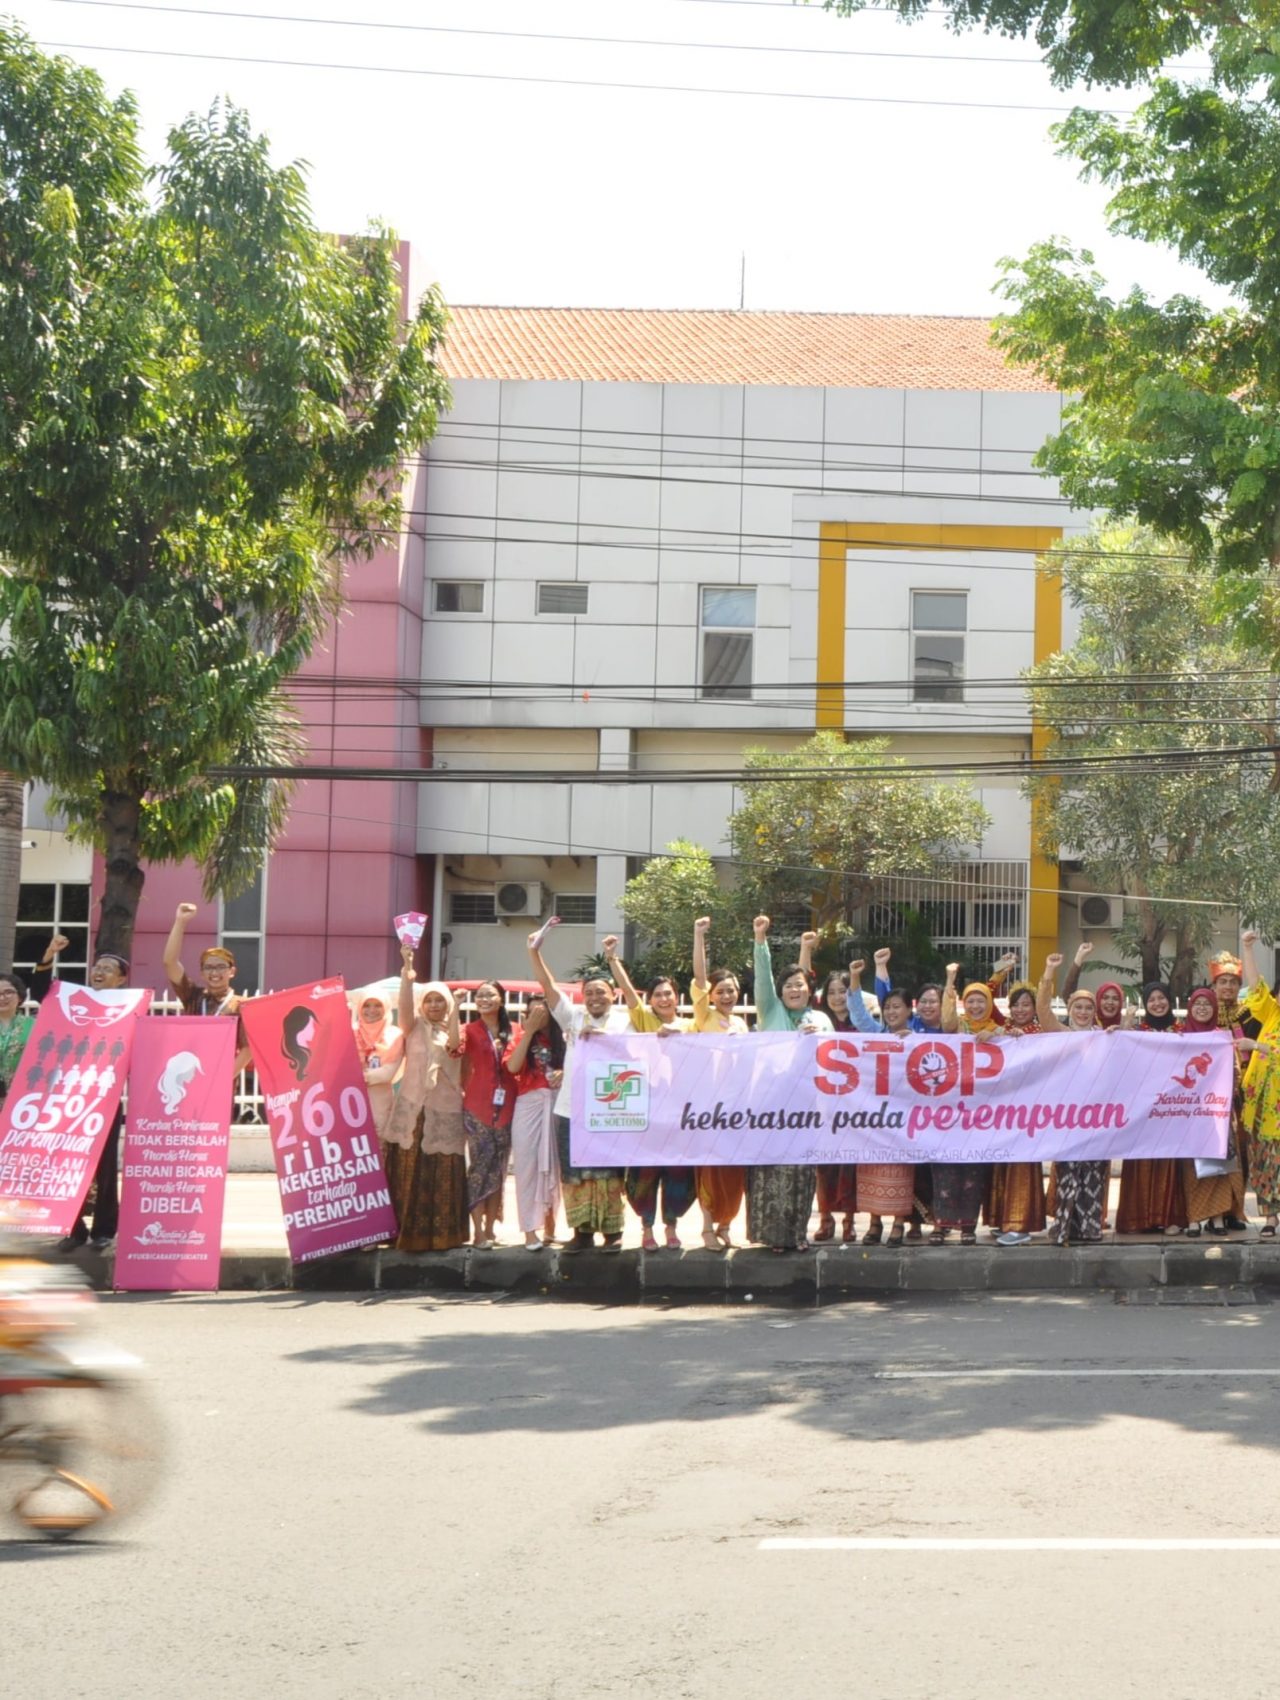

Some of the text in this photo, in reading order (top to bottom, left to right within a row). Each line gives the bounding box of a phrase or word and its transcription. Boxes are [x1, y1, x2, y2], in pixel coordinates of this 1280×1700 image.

[814, 1039, 1005, 1097] STOP
[1203, 1092, 1229, 1108] Day
[10, 1092, 105, 1137] 65%
[271, 1082, 368, 1149] 260
[604, 1117, 647, 1127] SOETOMO
[680, 1101, 1128, 1139] kekerasan pada perempuan
[0, 1129, 96, 1156] perempuan
[127, 1134, 228, 1148] TIDAK BERSALAH
[283, 1134, 372, 1175] ribu
[862, 1149, 937, 1162] UNIVERSITAS
[0, 1164, 84, 1186] ELECEHAN
[125, 1165, 224, 1179] BERANI BICARA
[279, 1154, 380, 1196] KEKERASAN
[5, 1180, 81, 1198] JALANAN
[307, 1180, 358, 1206] terhadap
[140, 1196, 204, 1215] DIBELA
[283, 1188, 391, 1231] PEREMPUAN
